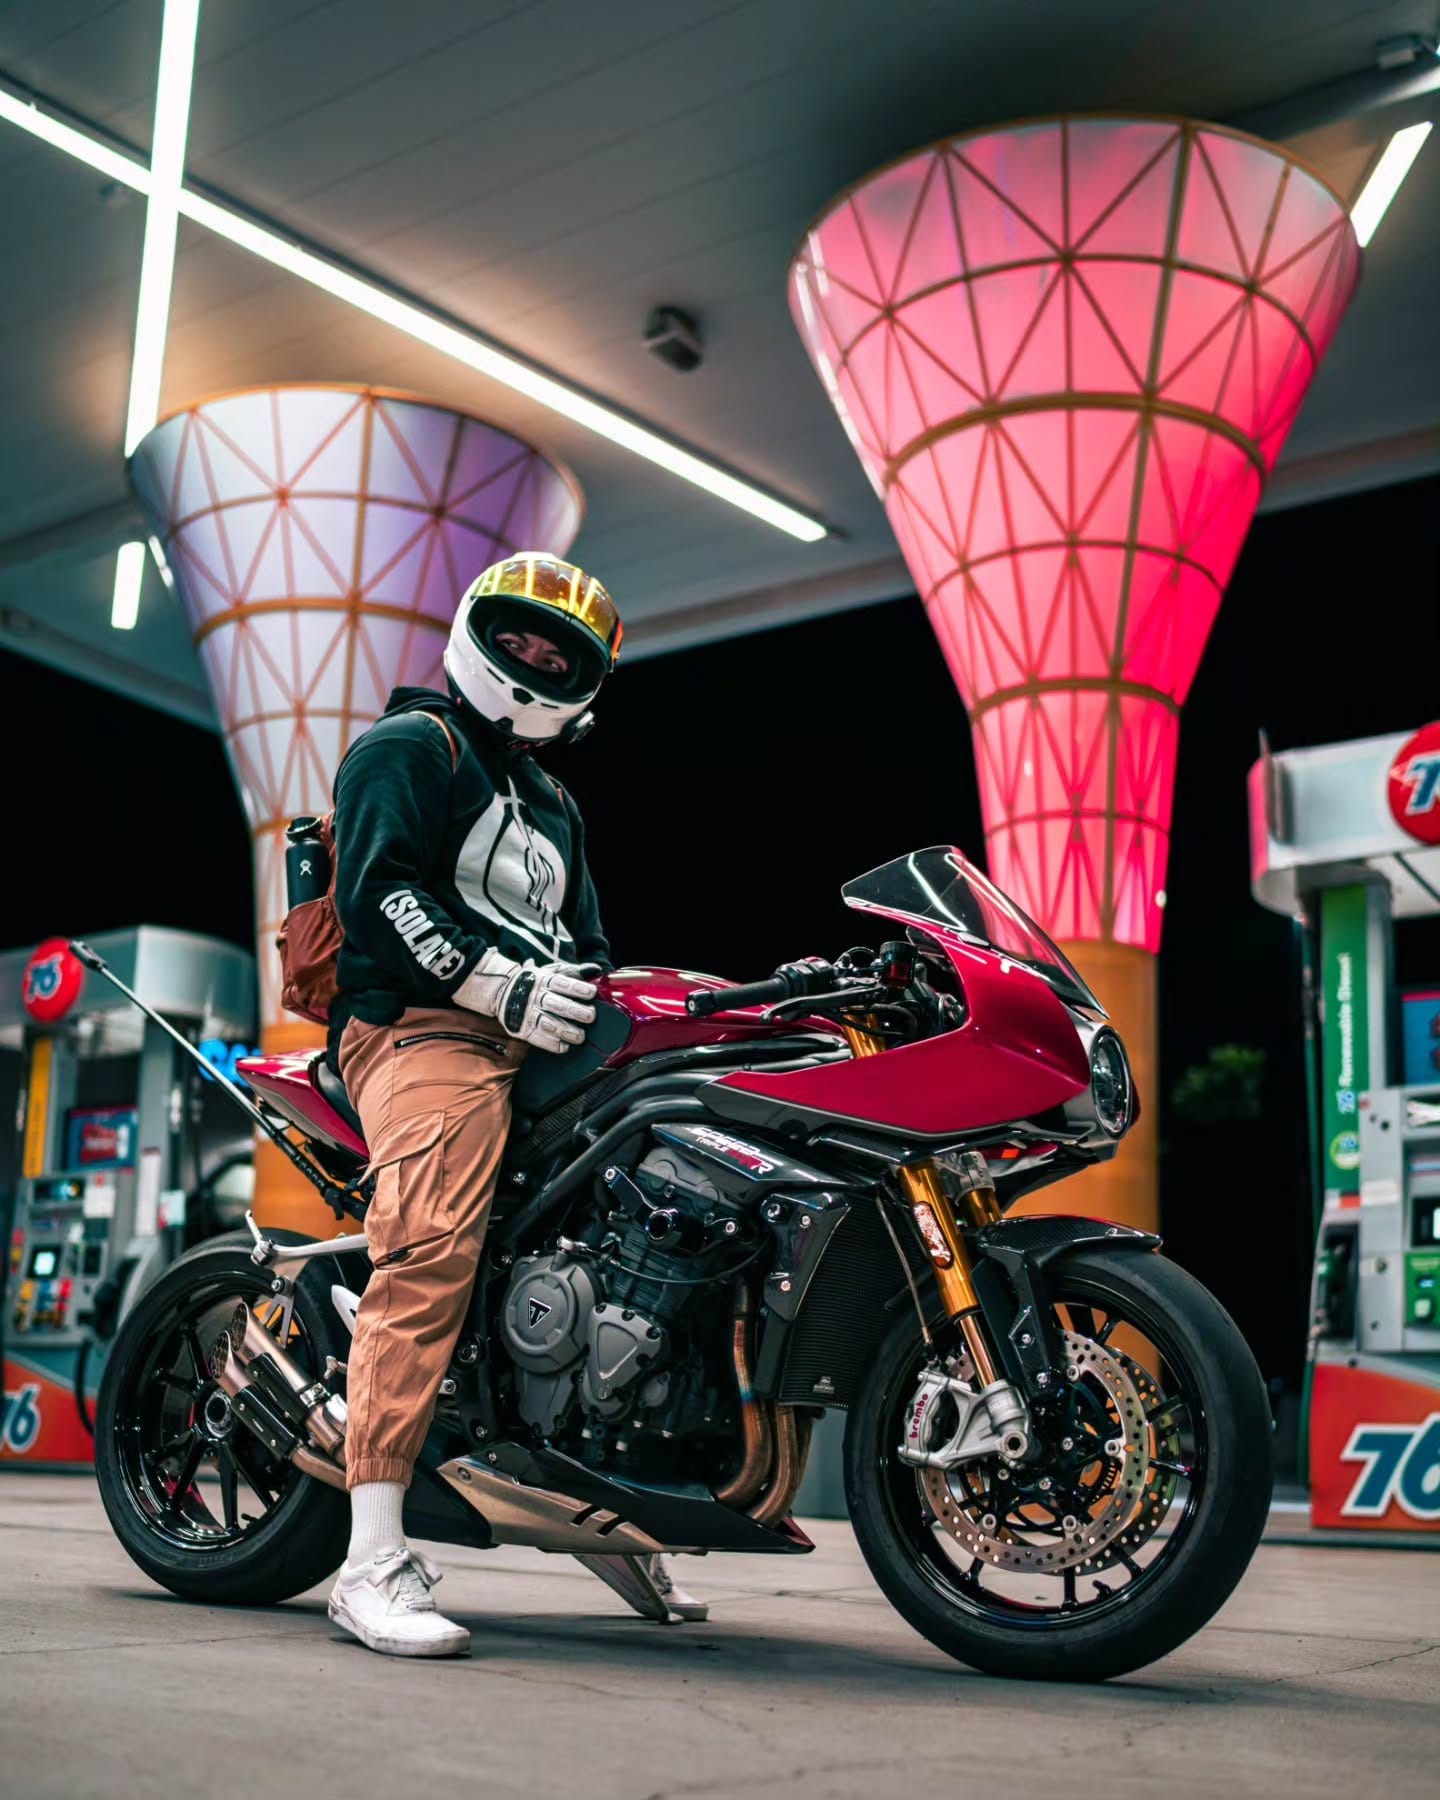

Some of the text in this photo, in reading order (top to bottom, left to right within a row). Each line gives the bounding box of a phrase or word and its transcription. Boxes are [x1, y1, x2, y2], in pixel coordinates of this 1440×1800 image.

[1405, 752, 1440, 816] 7
[25, 953, 64, 1003] 76
[908, 1393, 930, 1440] brembo
